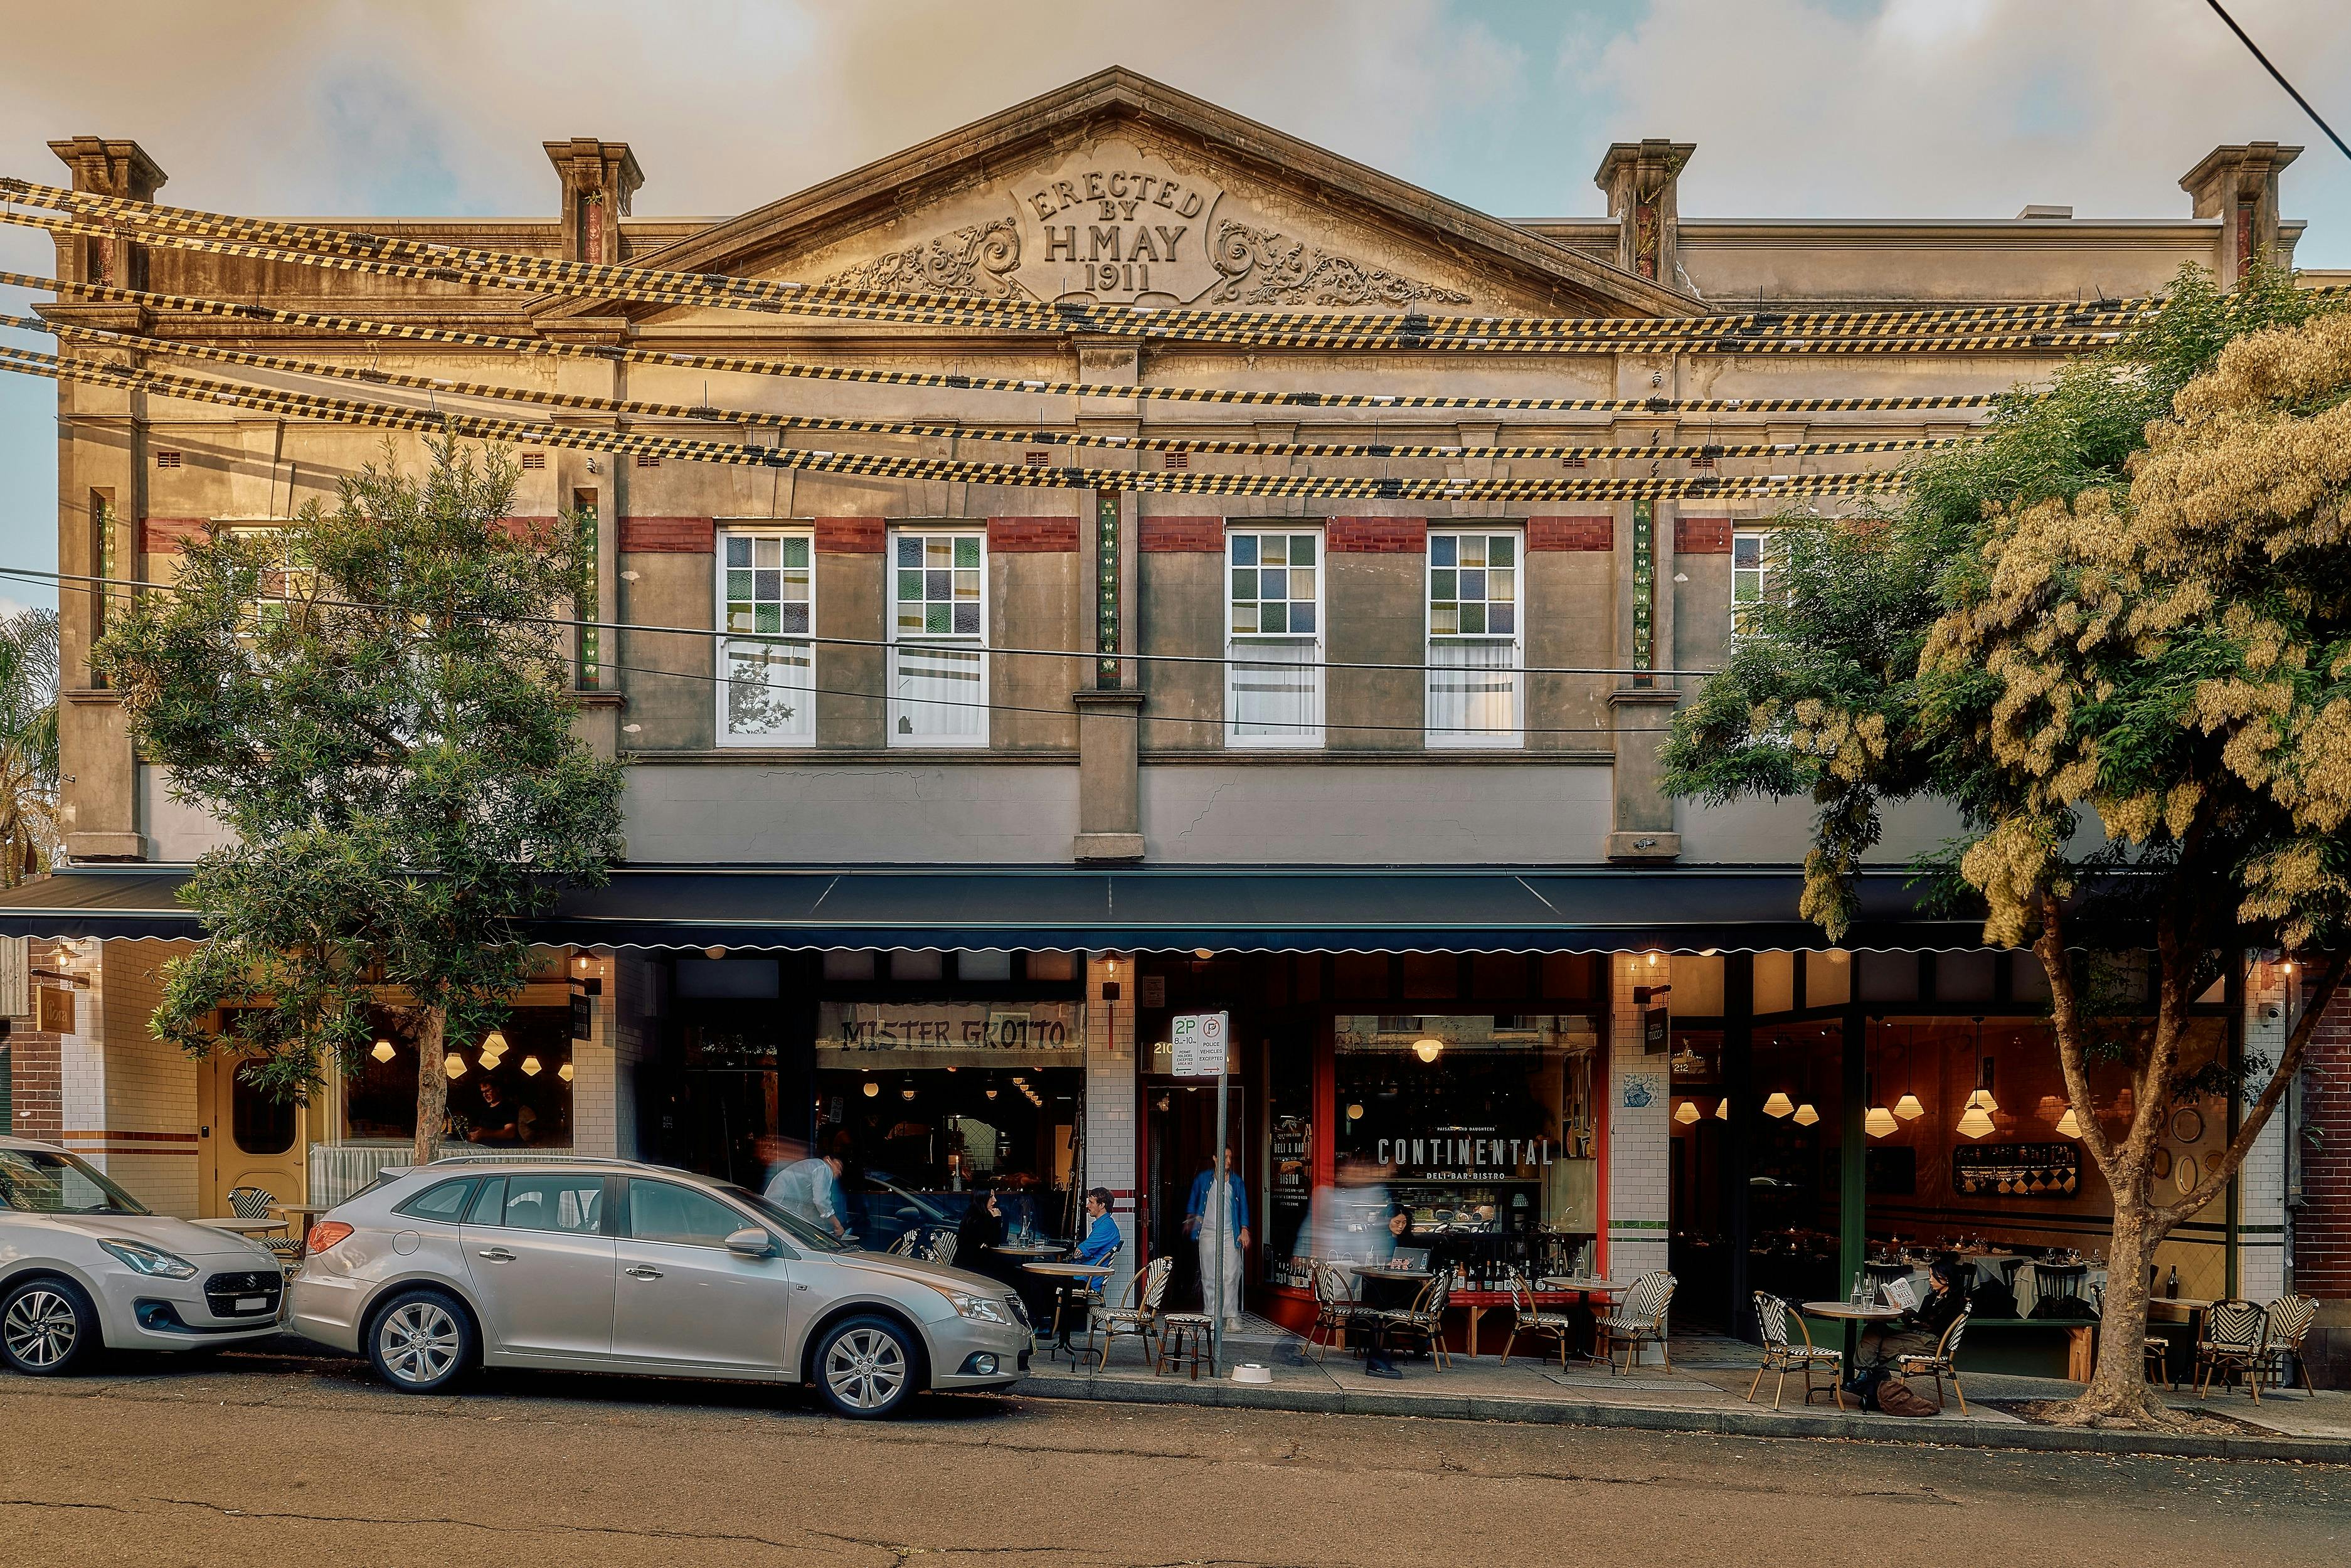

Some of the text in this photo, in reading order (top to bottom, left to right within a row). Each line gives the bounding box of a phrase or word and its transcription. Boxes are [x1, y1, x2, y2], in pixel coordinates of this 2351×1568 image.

[1028, 170, 1203, 221] ERECTED
[1098, 199, 1138, 221] BY
[1085, 263, 1149, 291] 1911
[45, 1000, 67, 1022] flora
[841, 1019, 1066, 1052] MISTER GROTTO
[1175, 1020, 1196, 1034] 2P
[1674, 1064, 1689, 1072] 212
[1274, 1143, 1285, 1153] DELI
[1295, 1142, 1305, 1153] BAR
[1378, 1138, 1553, 1165] CONTINENTAL
[1280, 1174, 1298, 1185] BISTRO
[1897, 1291, 1911, 1299] BELL
